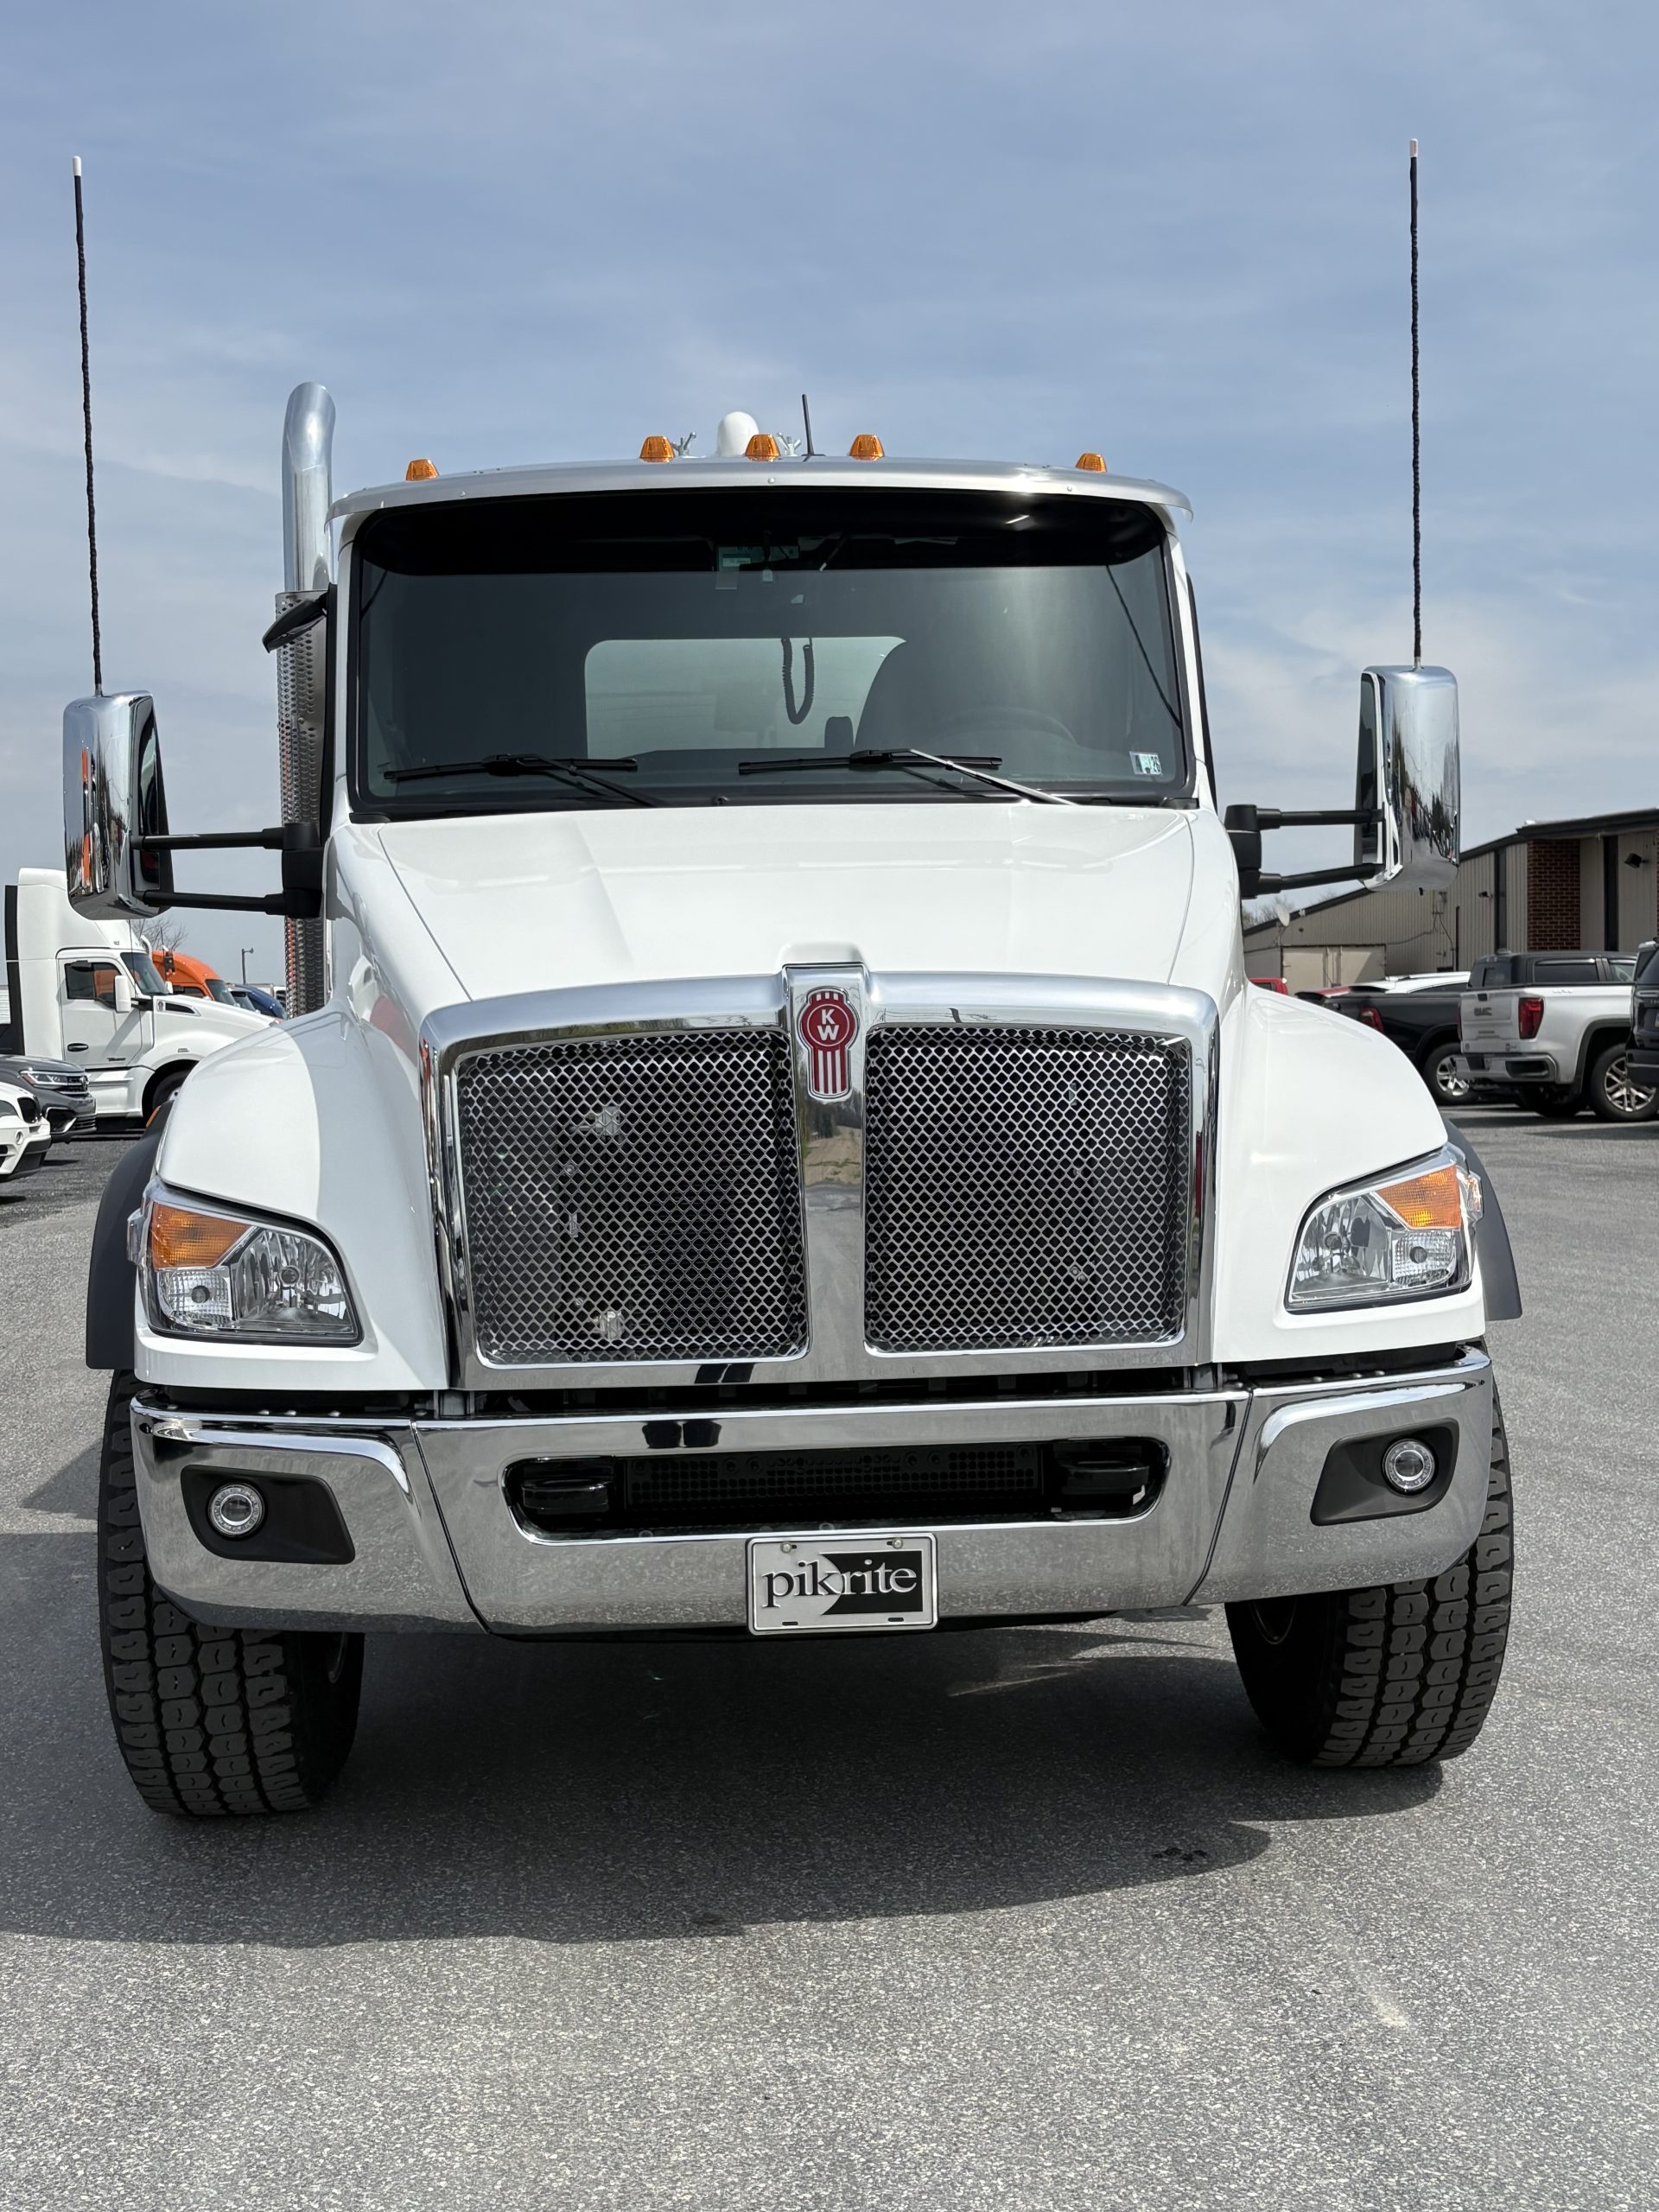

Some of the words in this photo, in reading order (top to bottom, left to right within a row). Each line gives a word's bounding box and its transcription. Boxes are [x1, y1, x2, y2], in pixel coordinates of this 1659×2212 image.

[822, 1008, 836, 1025] K
[817, 1025, 839, 1040] W
[761, 1558, 918, 1609] pikrite
